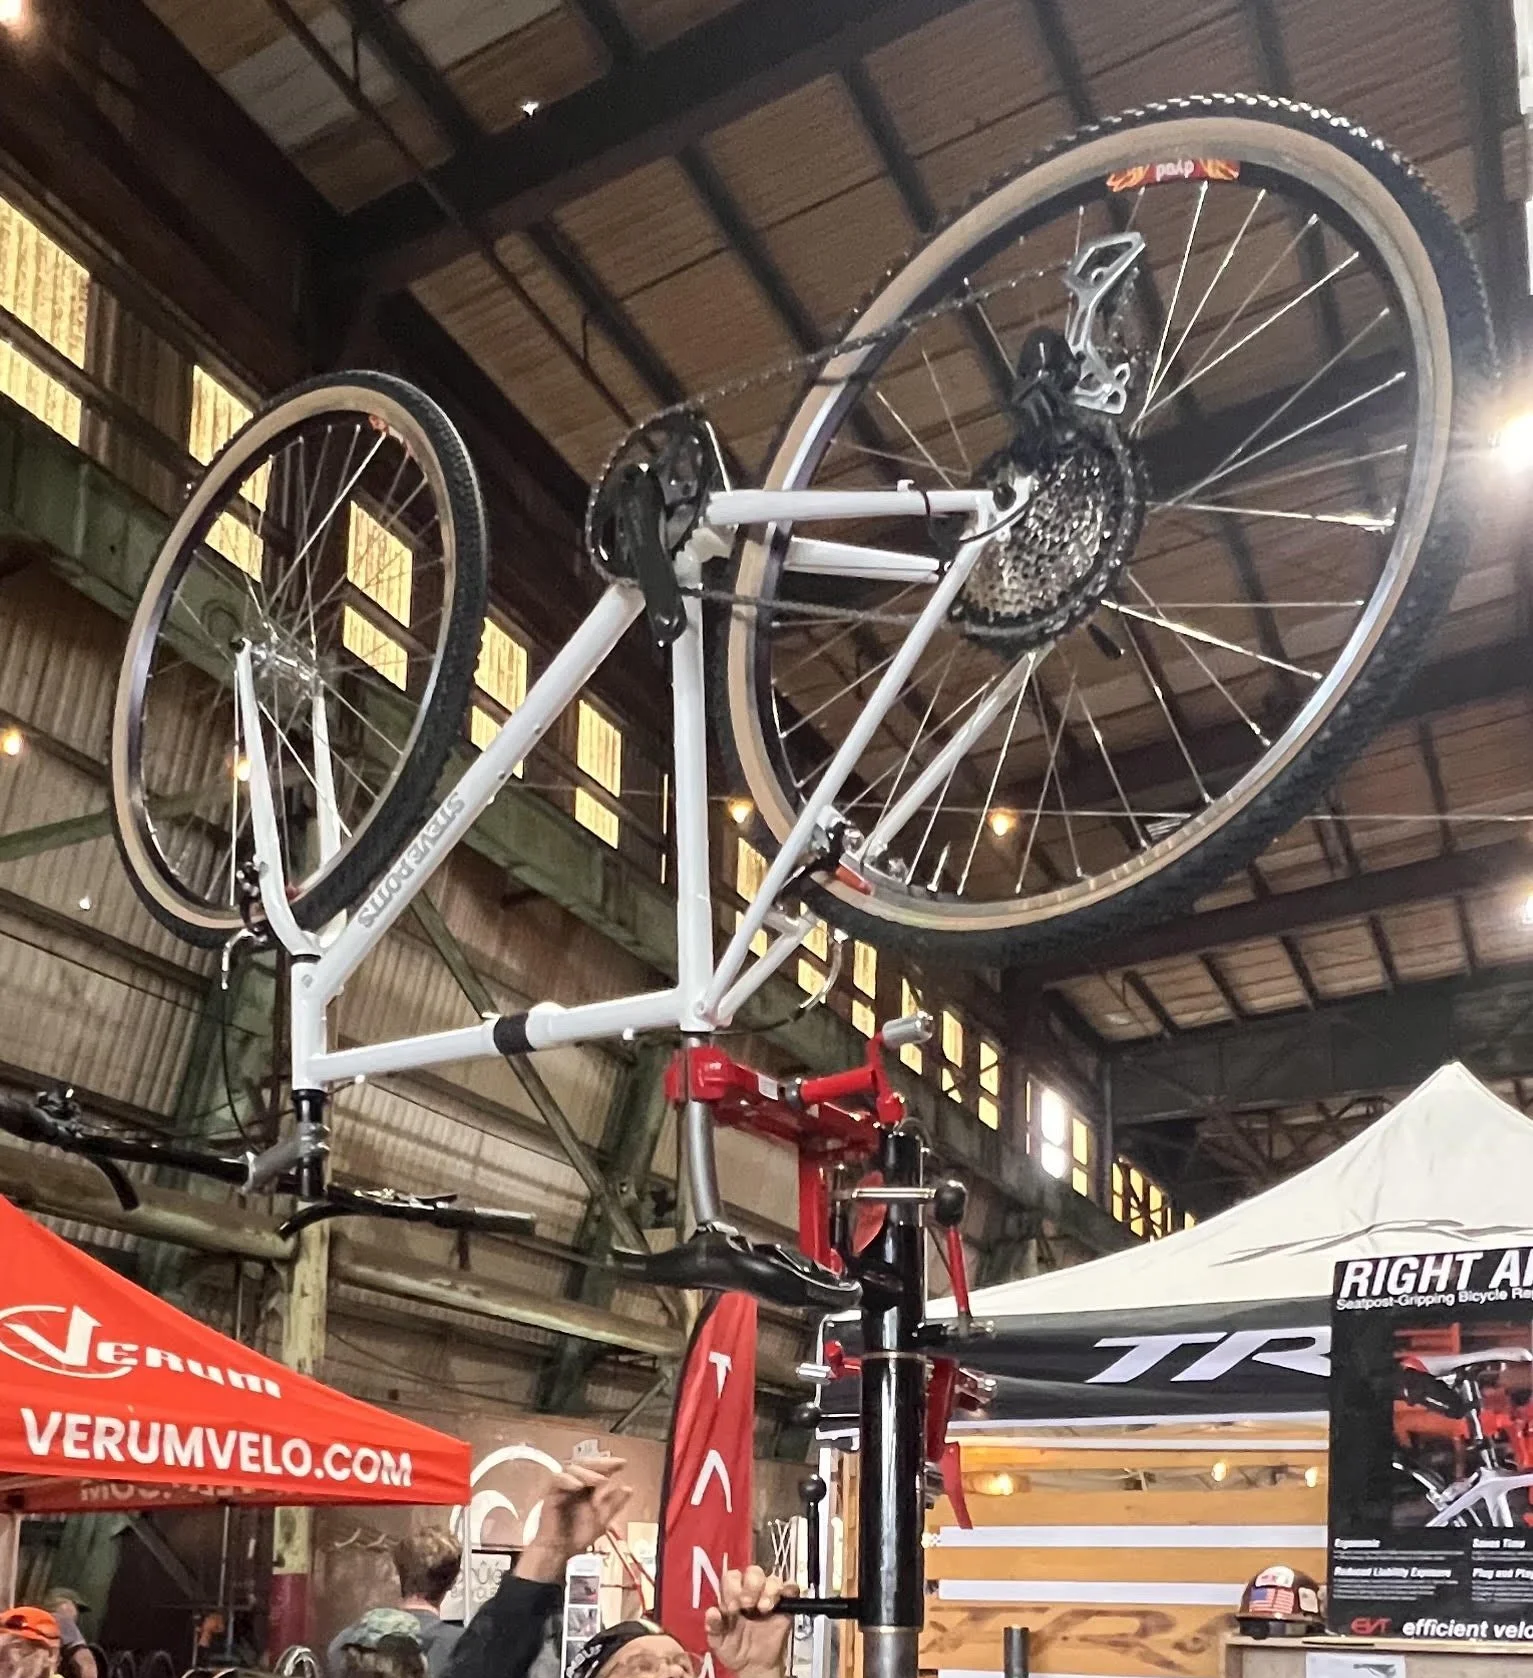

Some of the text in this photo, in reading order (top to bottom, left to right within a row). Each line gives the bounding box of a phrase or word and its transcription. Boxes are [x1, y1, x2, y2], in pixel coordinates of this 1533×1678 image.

[357, 792, 465, 928] STEVE POTTS
[1339, 1251, 1484, 1299] RIGHT
[1336, 1291, 1456, 1312] Seatpost-Gripping
[1458, 1289, 1508, 1305] Bicycle
[20, 1407, 413, 1488] VERUMVELO.COM
[1402, 1618, 1533, 1640] efficient velo
